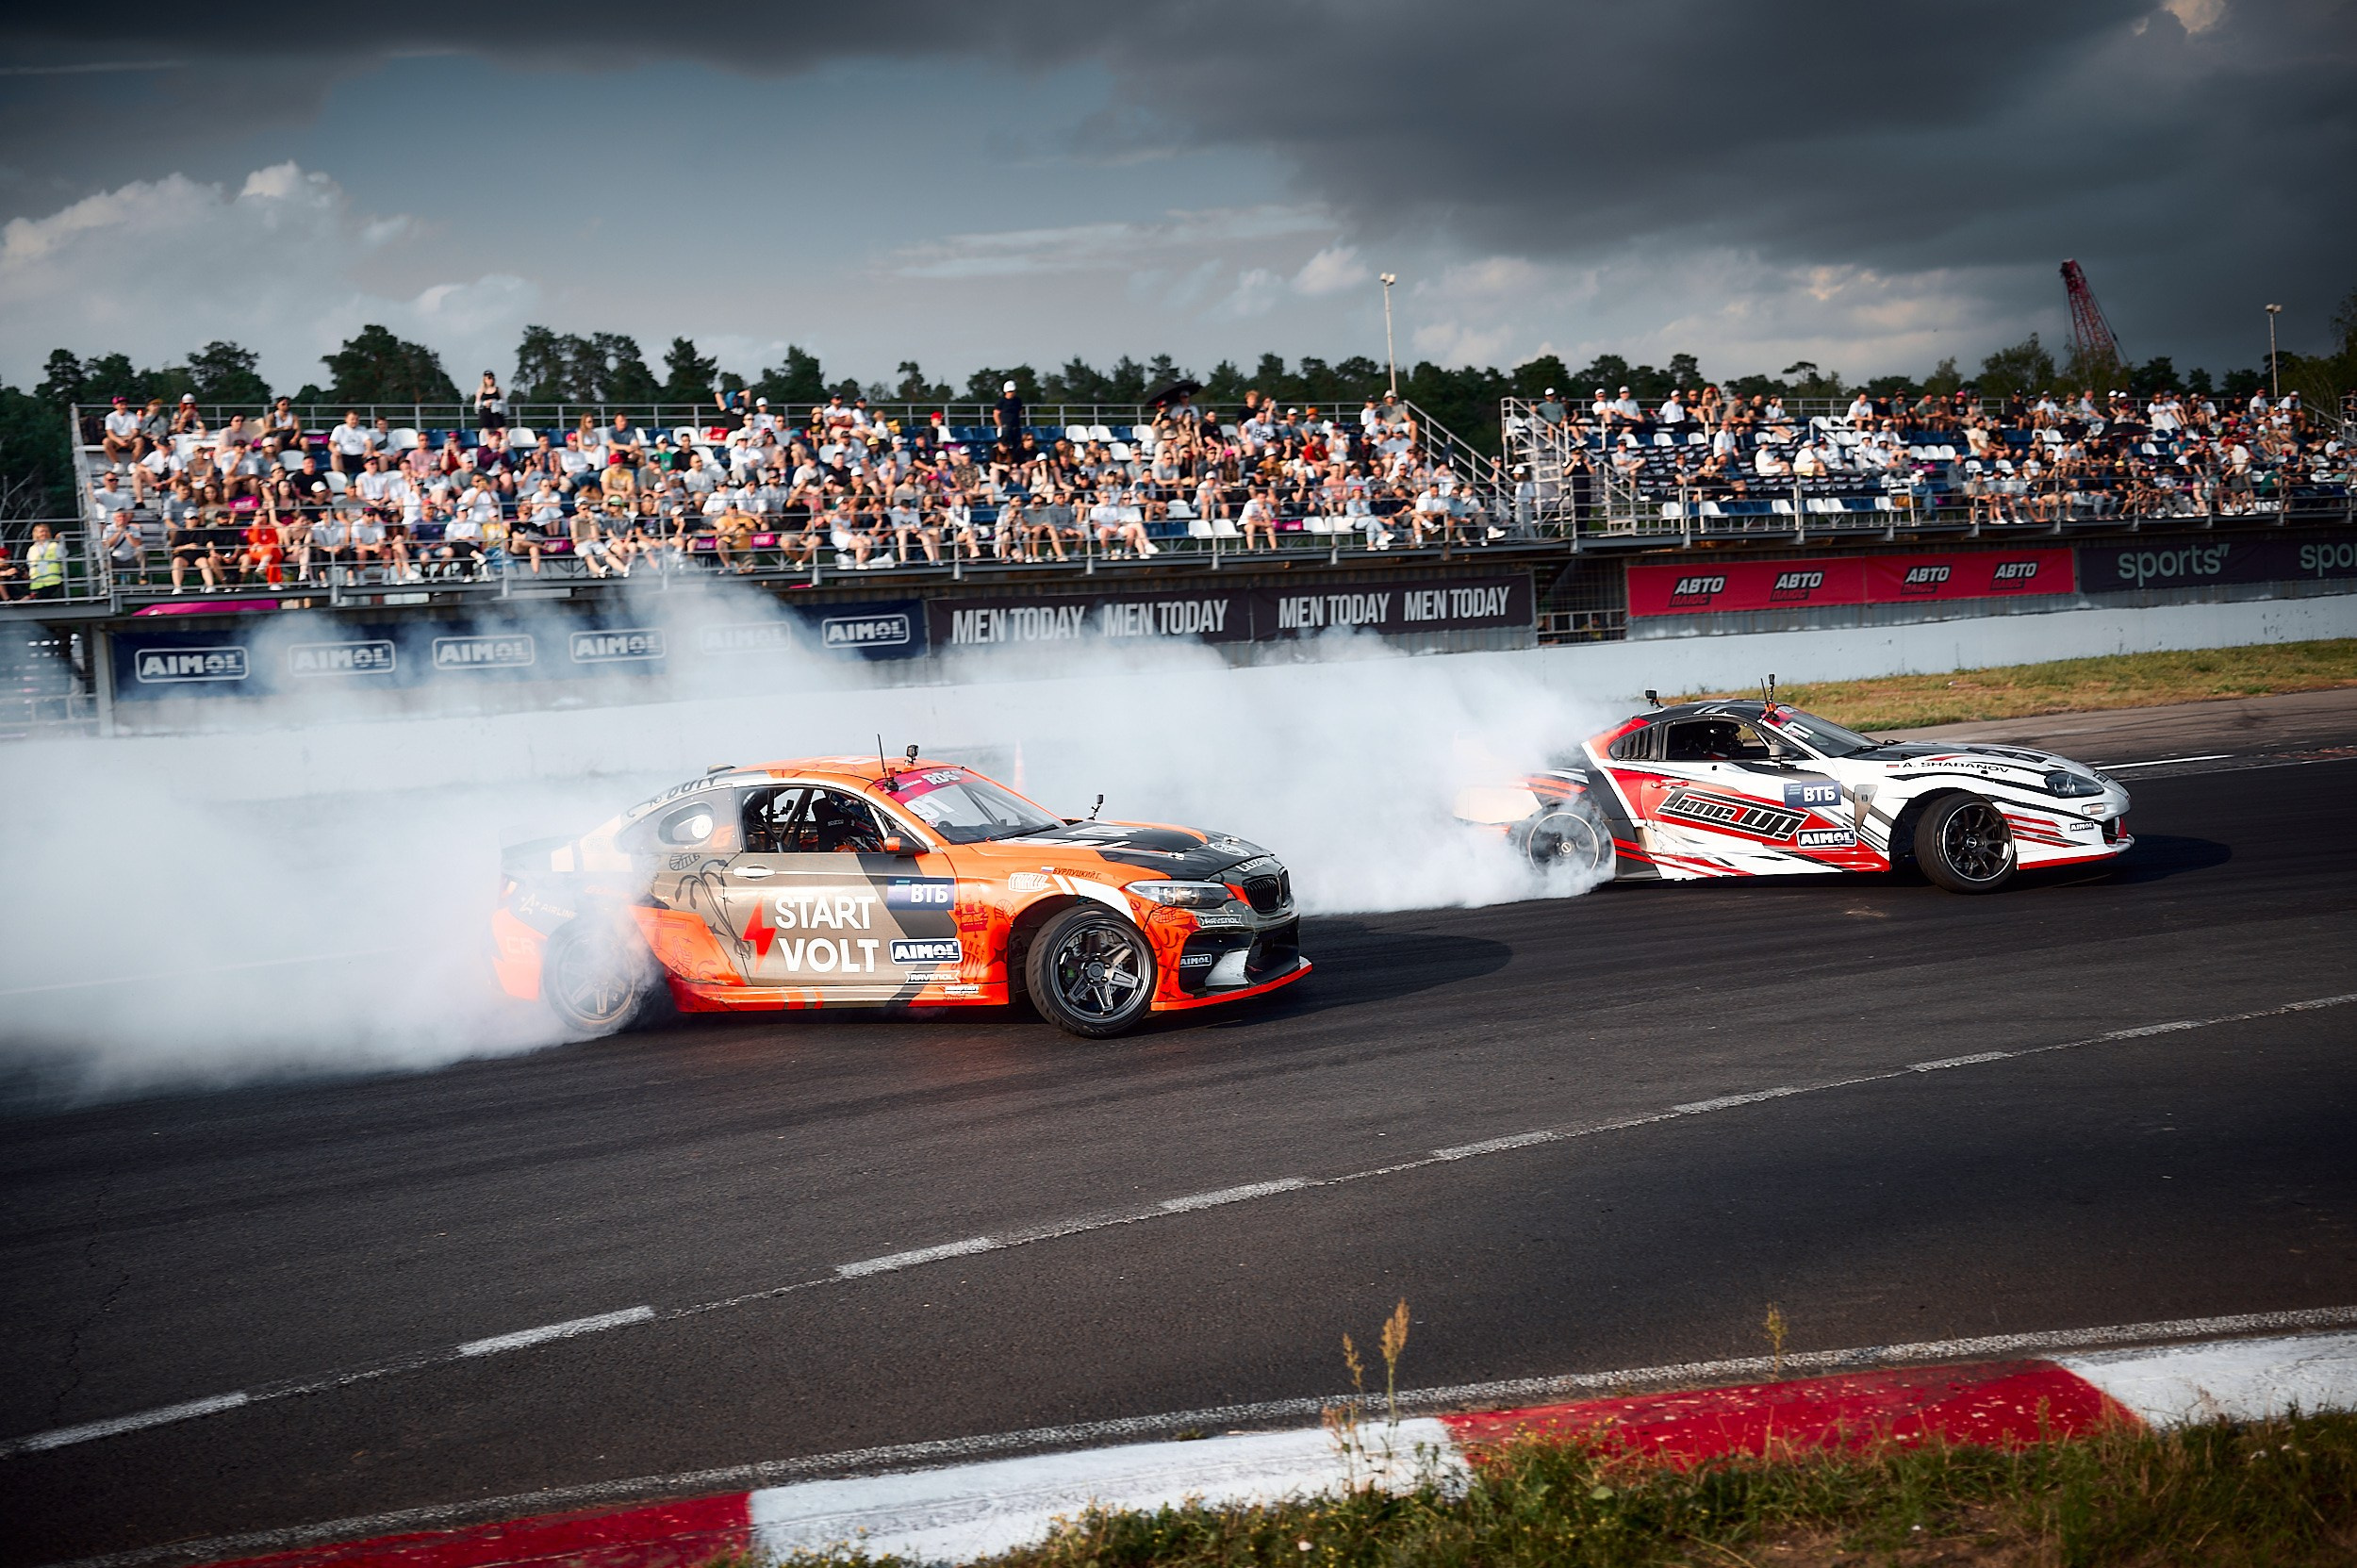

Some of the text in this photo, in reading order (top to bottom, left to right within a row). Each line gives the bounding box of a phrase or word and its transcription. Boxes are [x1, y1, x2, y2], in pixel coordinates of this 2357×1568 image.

[1774, 571, 1823, 589] АВТО
[1904, 567, 1951, 583] АВТО
[1994, 563, 2037, 579] АВТО
[1674, 577, 1725, 595] АВТО
[1278, 593, 1392, 628] MEN TODAY
[1404, 586, 1509, 621] MEN TODAY
[952, 605, 1085, 644] MEN TODAY
[1103, 599, 1228, 637] MEN TODAY
[827, 621, 905, 642] AIMOL
[438, 641, 529, 663] AIMOL
[575, 635, 659, 656] AIMOL
[141, 654, 243, 676] AIMOL
[294, 647, 390, 670] AIMOL
[1921, 762, 2009, 772] SHABANOV
[1803, 785, 1837, 802] ВТБ
[904, 795, 956, 820] 91
[2070, 822, 2093, 831] AIMOL
[1800, 832, 1854, 846] AIMOL
[1052, 867, 1096, 879] БУРЛУЦКИЙ
[911, 883, 948, 903] ВТБ
[775, 896, 877, 930] START
[777, 937, 880, 973] VOLT
[894, 943, 959, 960] AIMOL
[1180, 956, 1211, 966] AIMOL
[910, 973, 955, 982] RAVENOL
